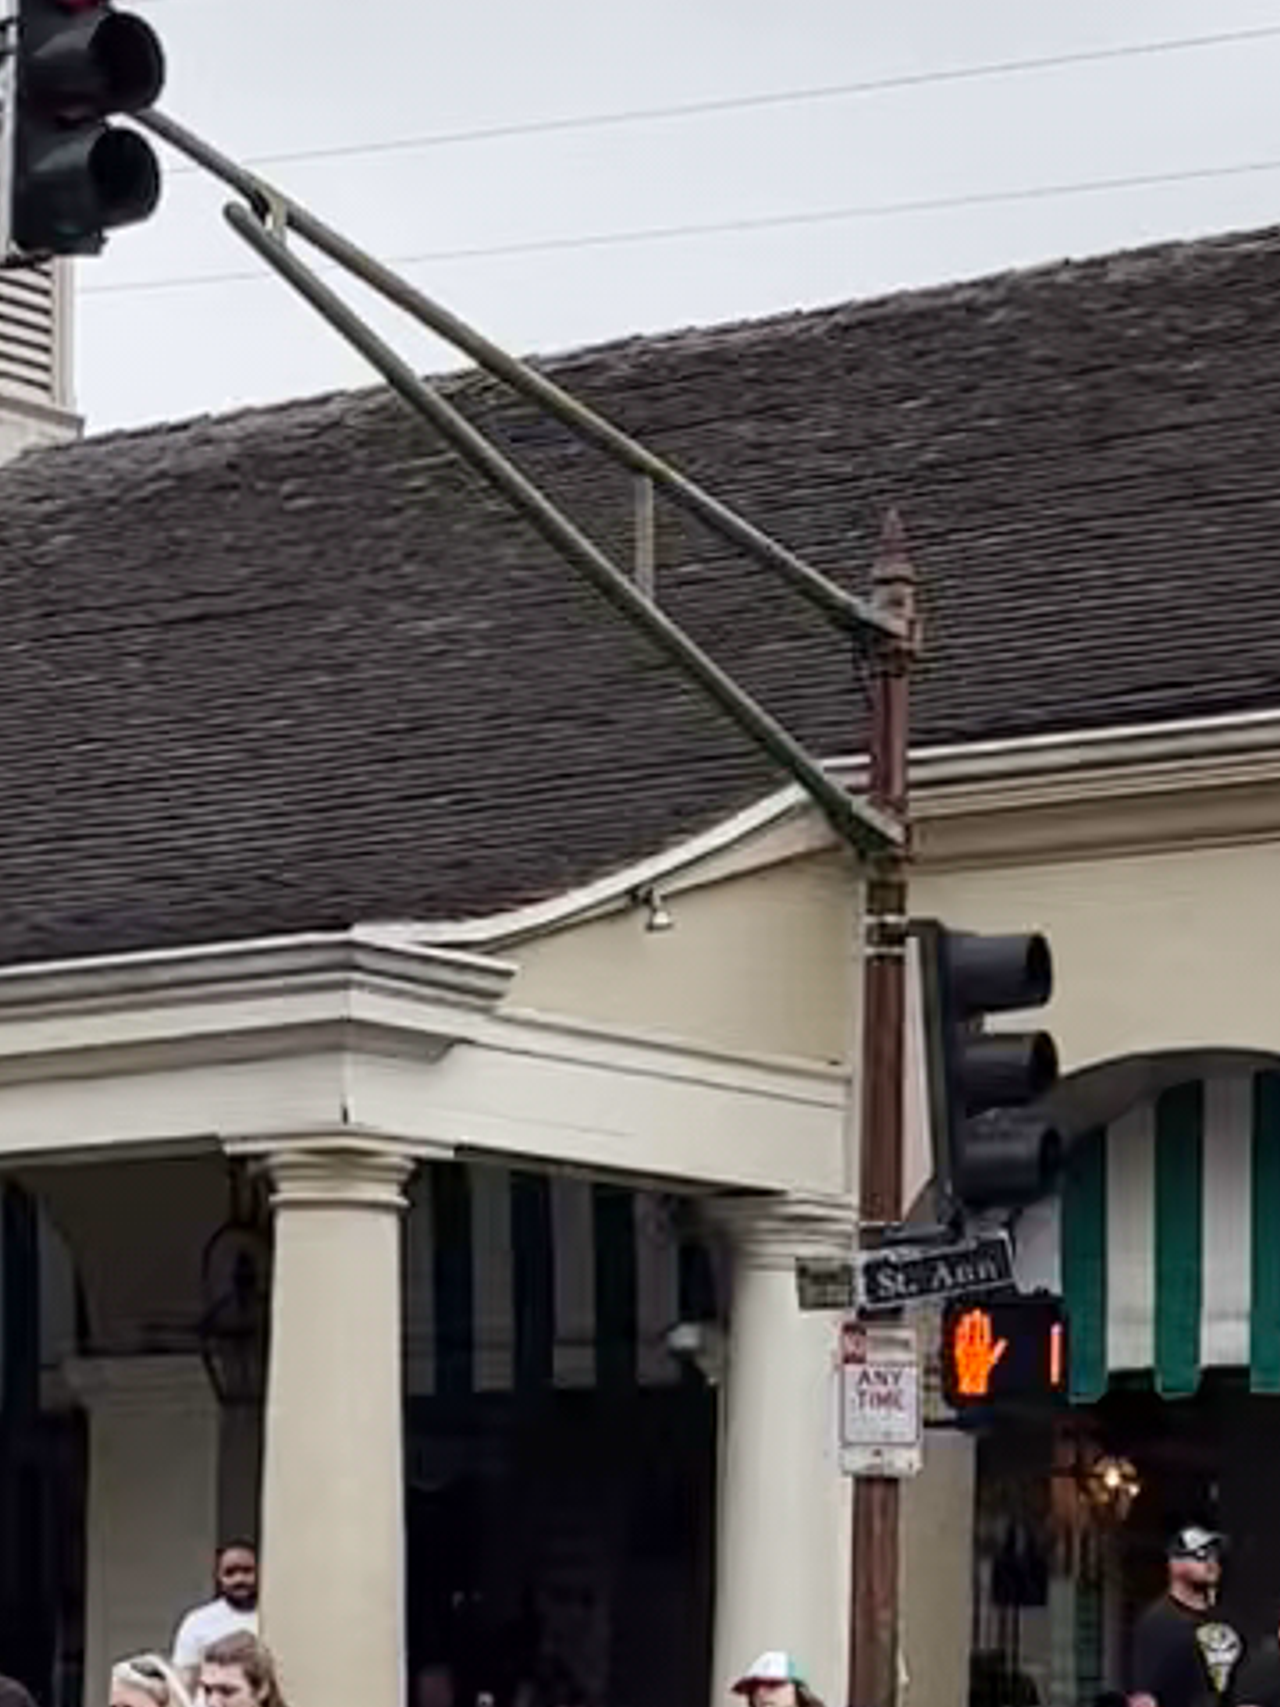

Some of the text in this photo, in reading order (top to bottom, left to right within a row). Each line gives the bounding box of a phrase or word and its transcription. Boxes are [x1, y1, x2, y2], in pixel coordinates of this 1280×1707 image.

[876, 1263, 919, 1297] St.
[930, 1253, 999, 1288] Ann
[856, 1369, 904, 1388] ANY
[855, 1392, 904, 1412] TIME
